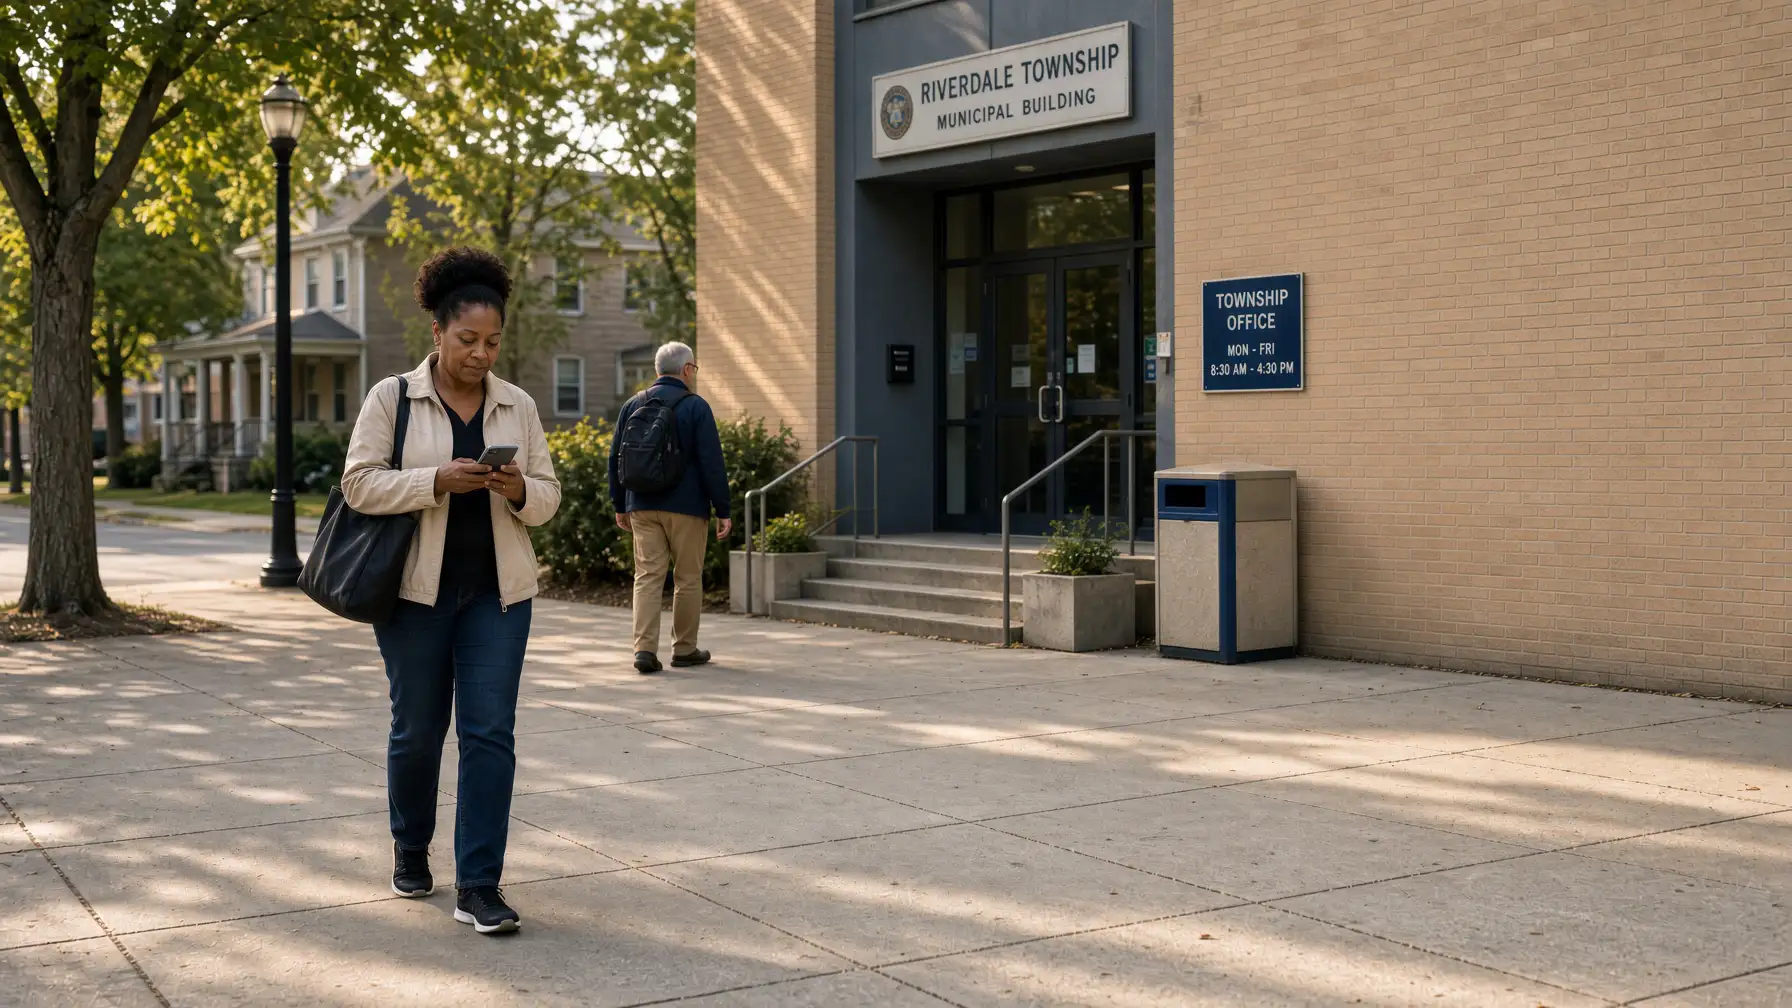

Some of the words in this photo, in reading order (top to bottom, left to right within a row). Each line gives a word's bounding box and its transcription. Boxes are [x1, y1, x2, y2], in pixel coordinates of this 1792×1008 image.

[921, 64, 1014, 104] RIVERDALE
[1021, 43, 1119, 84] TOWNSHIP
[937, 102, 1014, 130] MUNICIPAL
[1022, 88, 1096, 116] BUILDING
[1215, 289, 1289, 309] TOWNSHIP
[1227, 312, 1276, 331] OFFICE
[1227, 343, 1249, 357] MON
[1259, 342, 1275, 355] FRI
[1210, 363, 1230, 376] 8:30
[1232, 362, 1247, 375] AM
[1256, 361, 1277, 375] 4:30
[1279, 361, 1294, 374] PM
